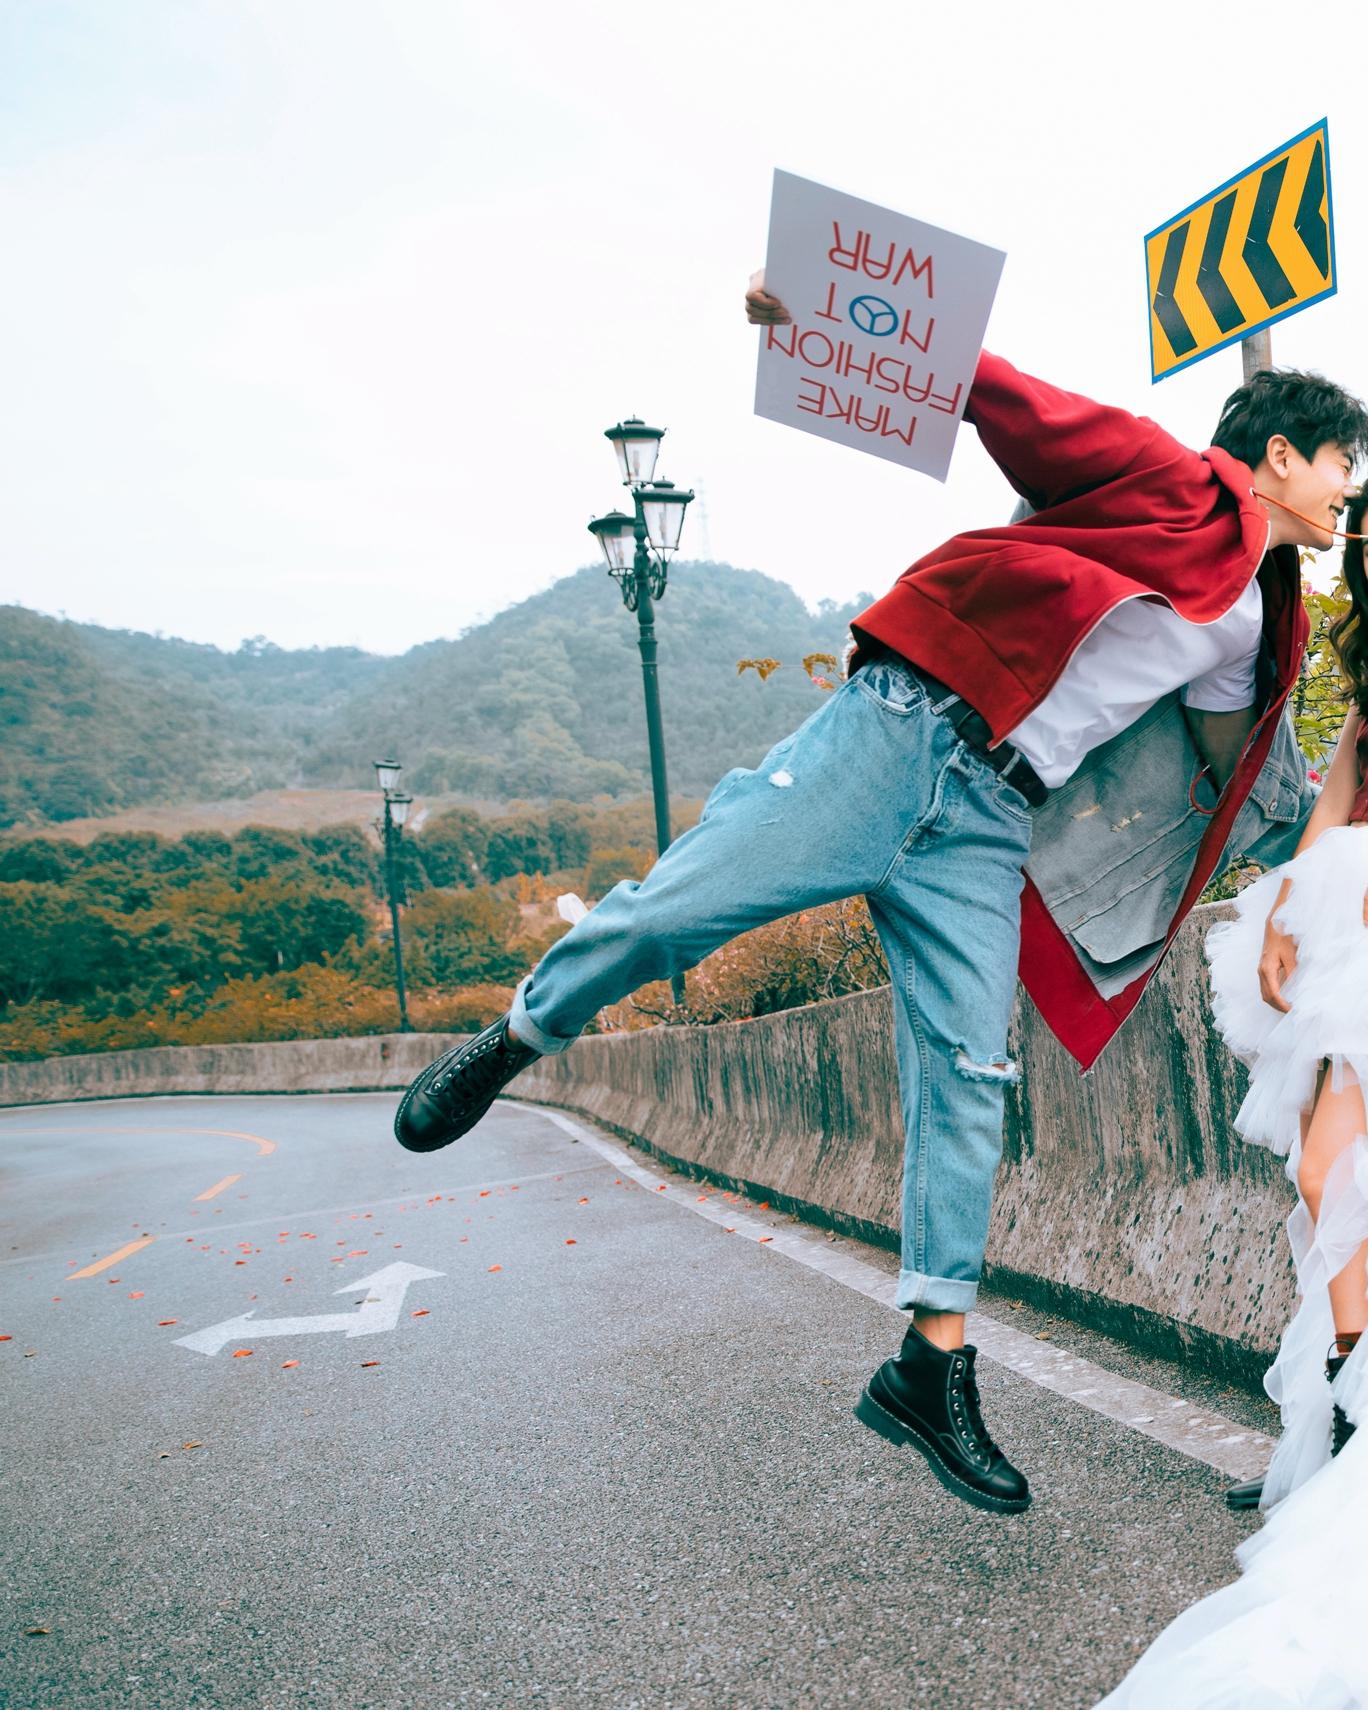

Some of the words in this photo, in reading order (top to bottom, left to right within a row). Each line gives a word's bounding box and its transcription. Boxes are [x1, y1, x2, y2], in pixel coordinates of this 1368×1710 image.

[828, 221, 934, 299] WAR
[767, 324, 963, 415] FASHION
[797, 377, 917, 446] MAKE
